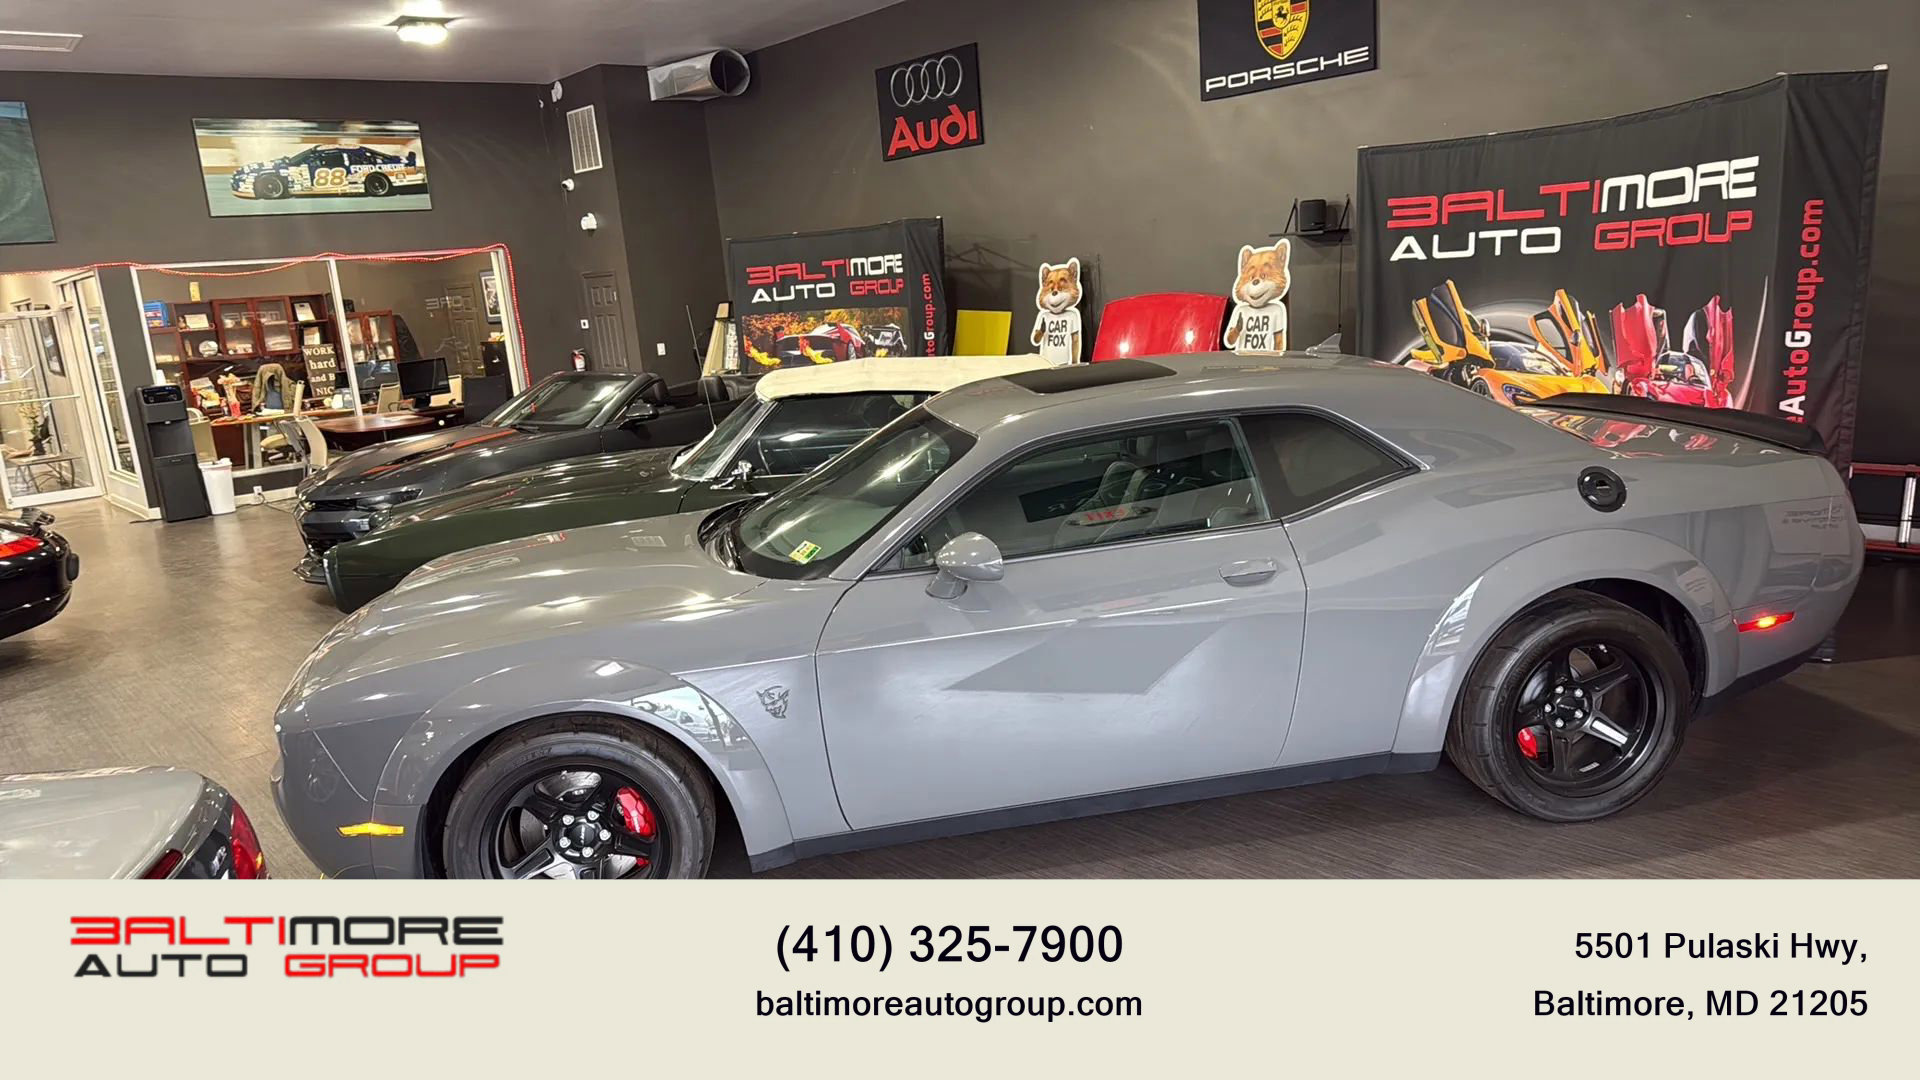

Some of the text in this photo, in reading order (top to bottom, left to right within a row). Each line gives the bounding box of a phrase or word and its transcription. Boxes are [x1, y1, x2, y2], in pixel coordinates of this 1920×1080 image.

[1205, 46, 1369, 93] PORSCHE
[887, 103, 978, 157] Audi
[313, 167, 347, 188] 88
[1389, 210, 1754, 262] AUTO GROUP
[751, 278, 904, 304] AUTO GROUP
[1048, 319, 1068, 333] CAR
[1245, 315, 1270, 332] CAR
[1047, 334, 1066, 347] FOX
[1244, 333, 1267, 349] FOX
[303, 346, 335, 356] WORK
[309, 358, 336, 370] hard
[311, 373, 327, 382] and
